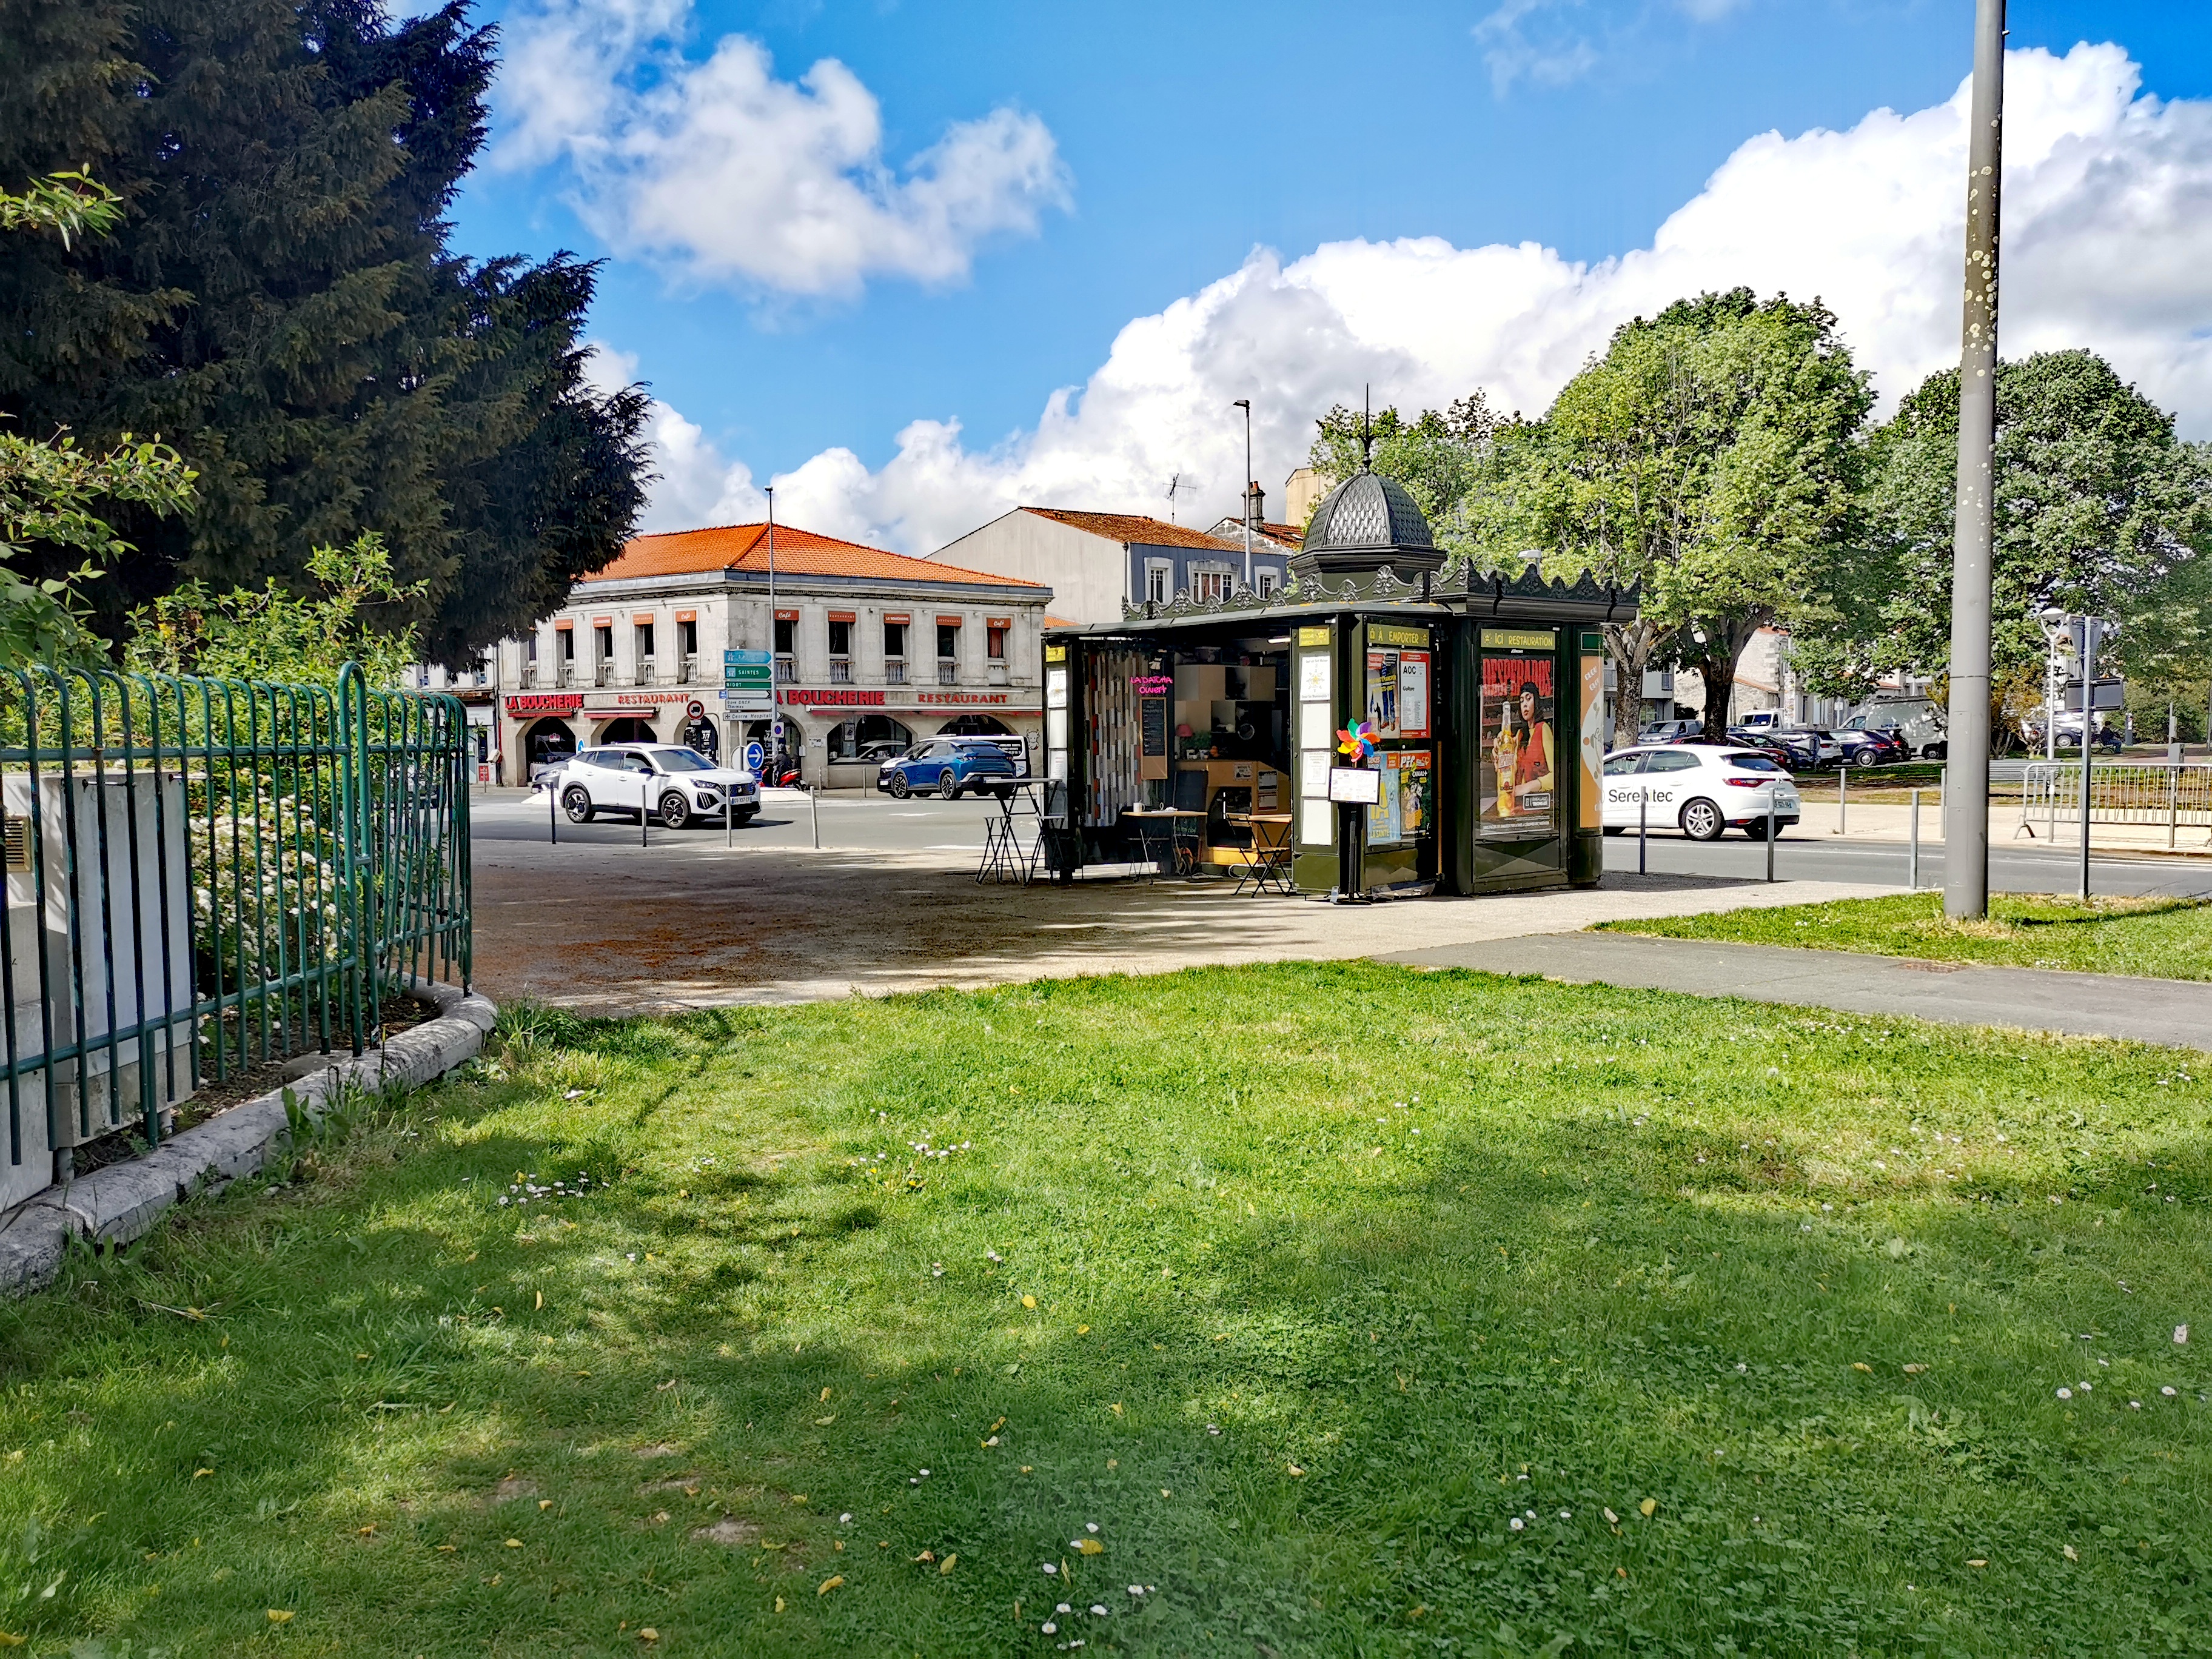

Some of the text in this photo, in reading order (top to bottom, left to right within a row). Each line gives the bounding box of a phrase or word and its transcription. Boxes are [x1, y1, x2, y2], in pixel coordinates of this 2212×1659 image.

[1389, 631, 1419, 644] EMPORTER
[1403, 666, 1416, 674] AOC
[1131, 675, 1141, 684] LA
[505, 694, 583, 709] LA BOUCHERIE
[618, 693, 689, 704] RESTAURANT
[788, 690, 885, 705] BOUCHERIE
[918, 693, 1008, 704] RESTAURANT
[1401, 756, 1415, 768] Pif
